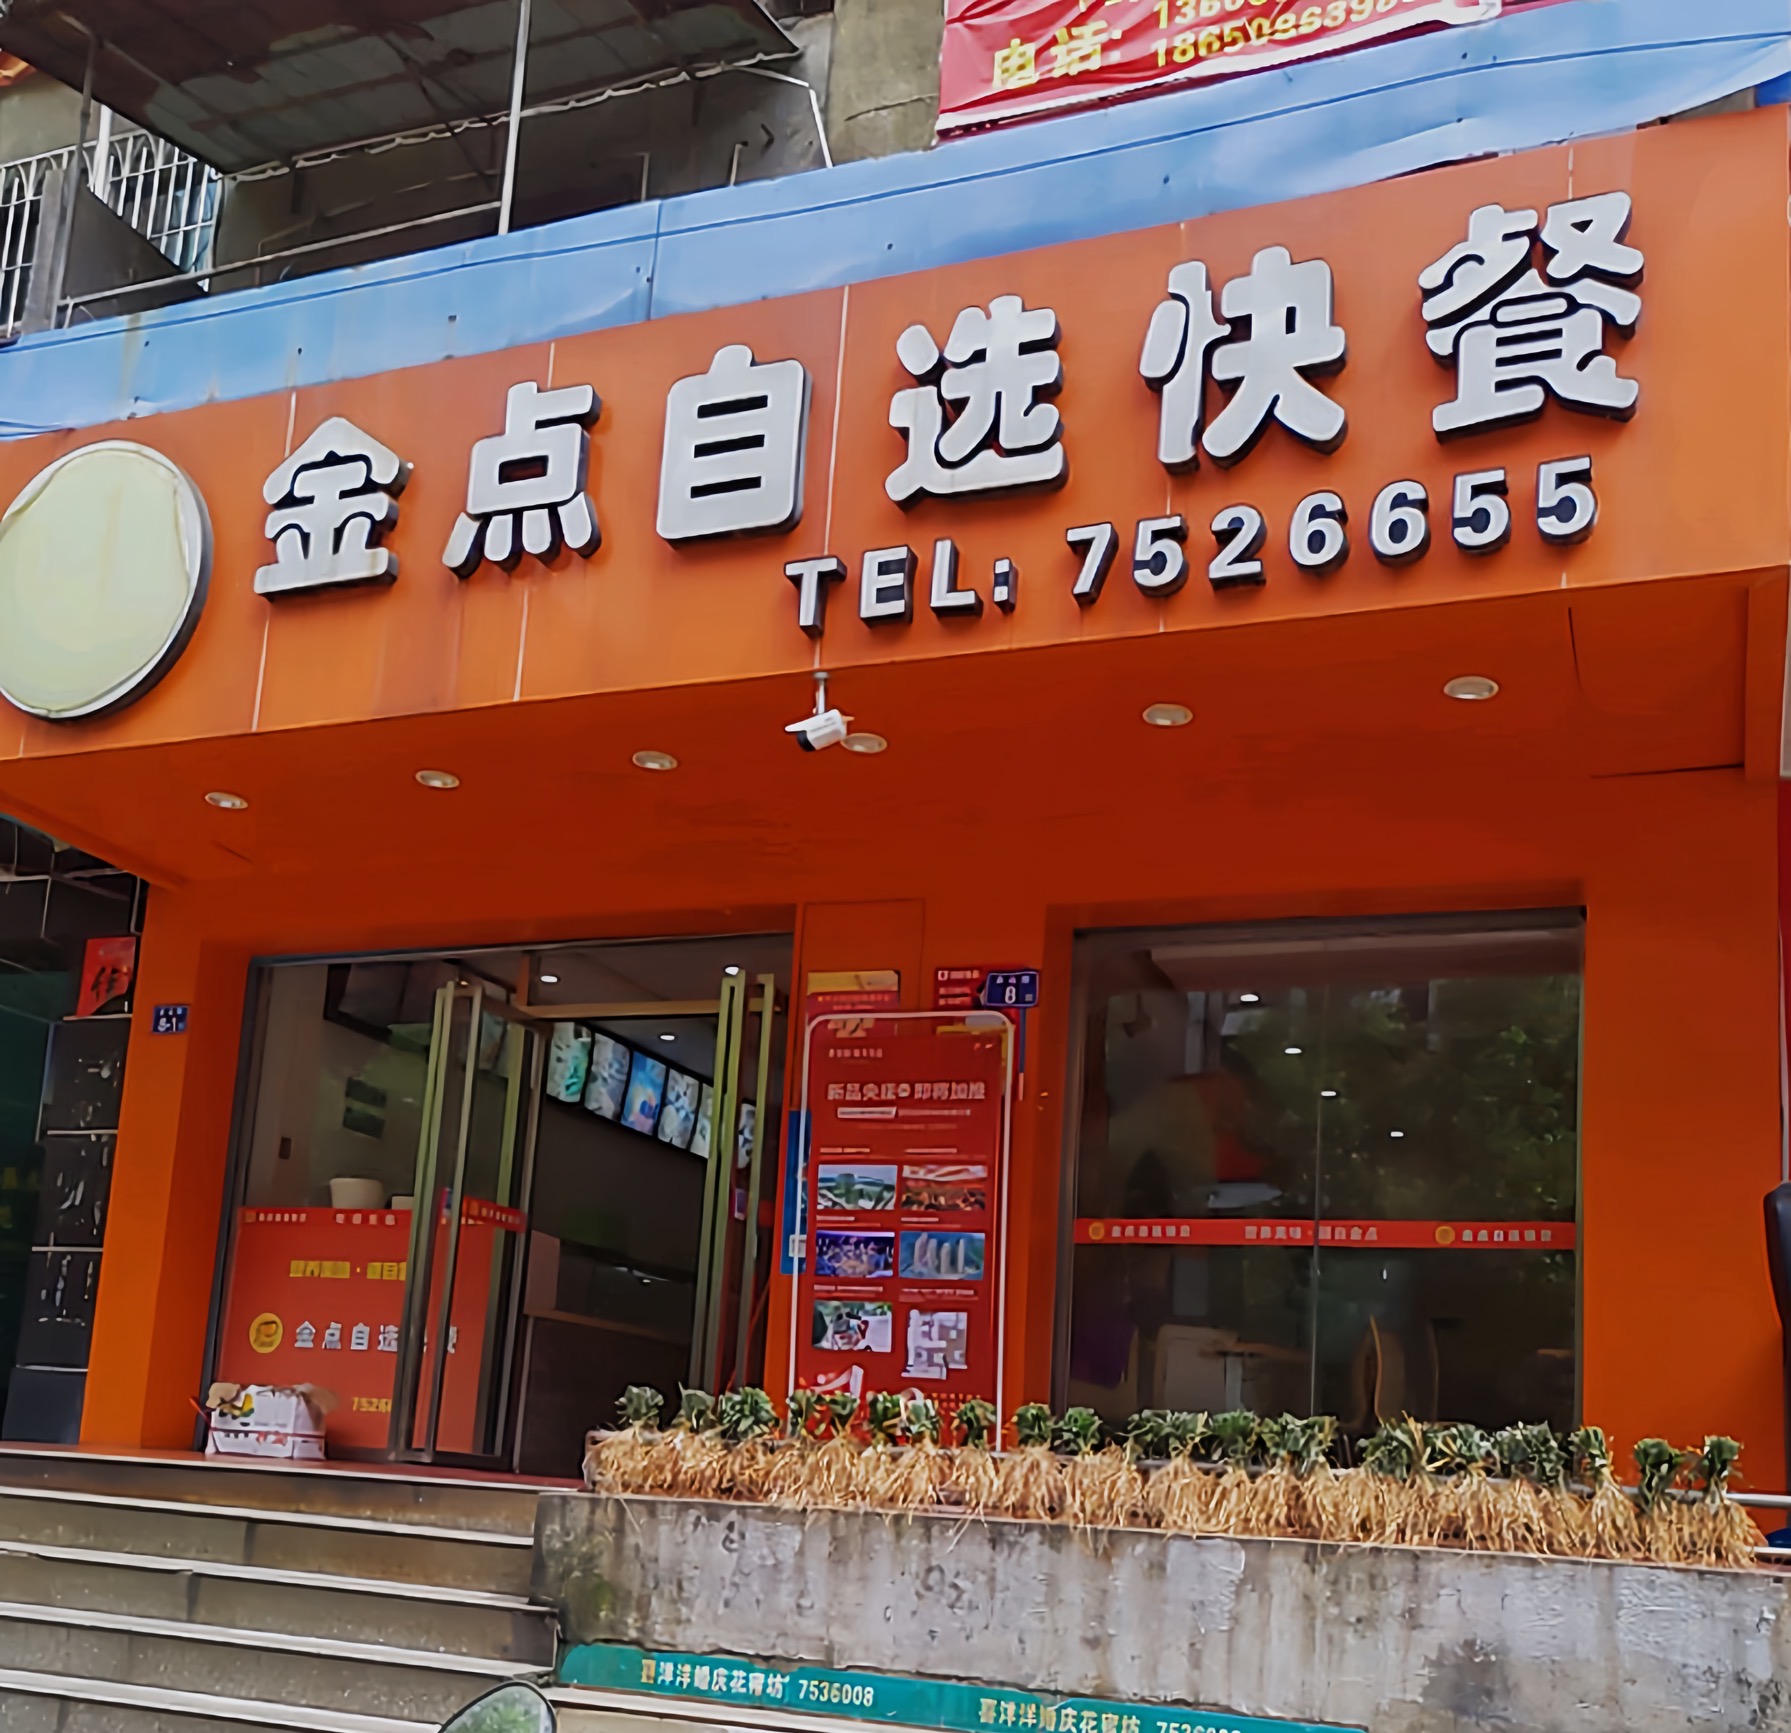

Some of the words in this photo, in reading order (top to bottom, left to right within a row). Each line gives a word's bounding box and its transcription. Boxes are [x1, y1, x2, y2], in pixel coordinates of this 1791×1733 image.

[254, 191, 1645, 599] 金点自选快餐
[784, 537, 1018, 636] TEL:
[1064, 455, 1598, 604] 7526655
[798, 1679, 874, 1707] 7536008
